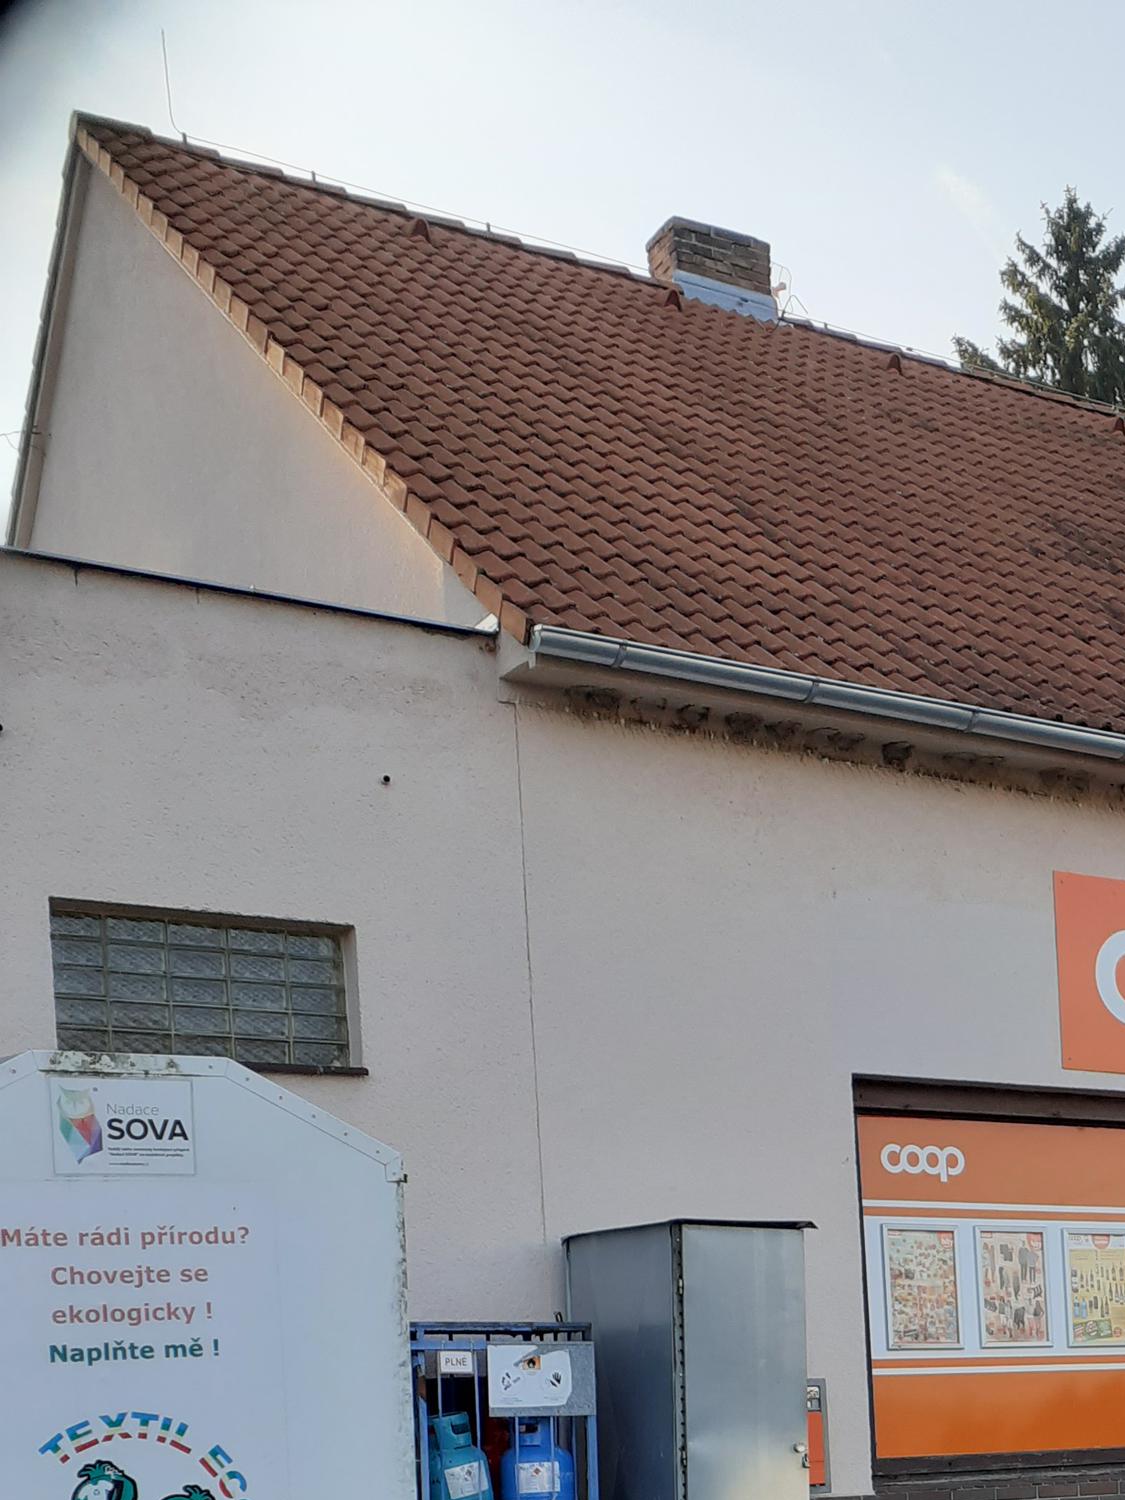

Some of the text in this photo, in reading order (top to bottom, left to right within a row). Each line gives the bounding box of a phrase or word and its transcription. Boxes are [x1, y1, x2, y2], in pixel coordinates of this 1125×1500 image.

[106, 1103, 159, 1116] Nadace
[107, 1117, 189, 1141] SOVA
[880, 1143, 965, 1182] coop
[0, 1225, 250, 1249] Máte rádi přírodu?
[51, 1265, 209, 1288] Chovejte se
[52, 1302, 195, 1326] ekologicky
[49, 1340, 155, 1366] Naplňte
[165, 1337, 203, 1358] mě
[38, 1411, 192, 1464] TEXTIL
